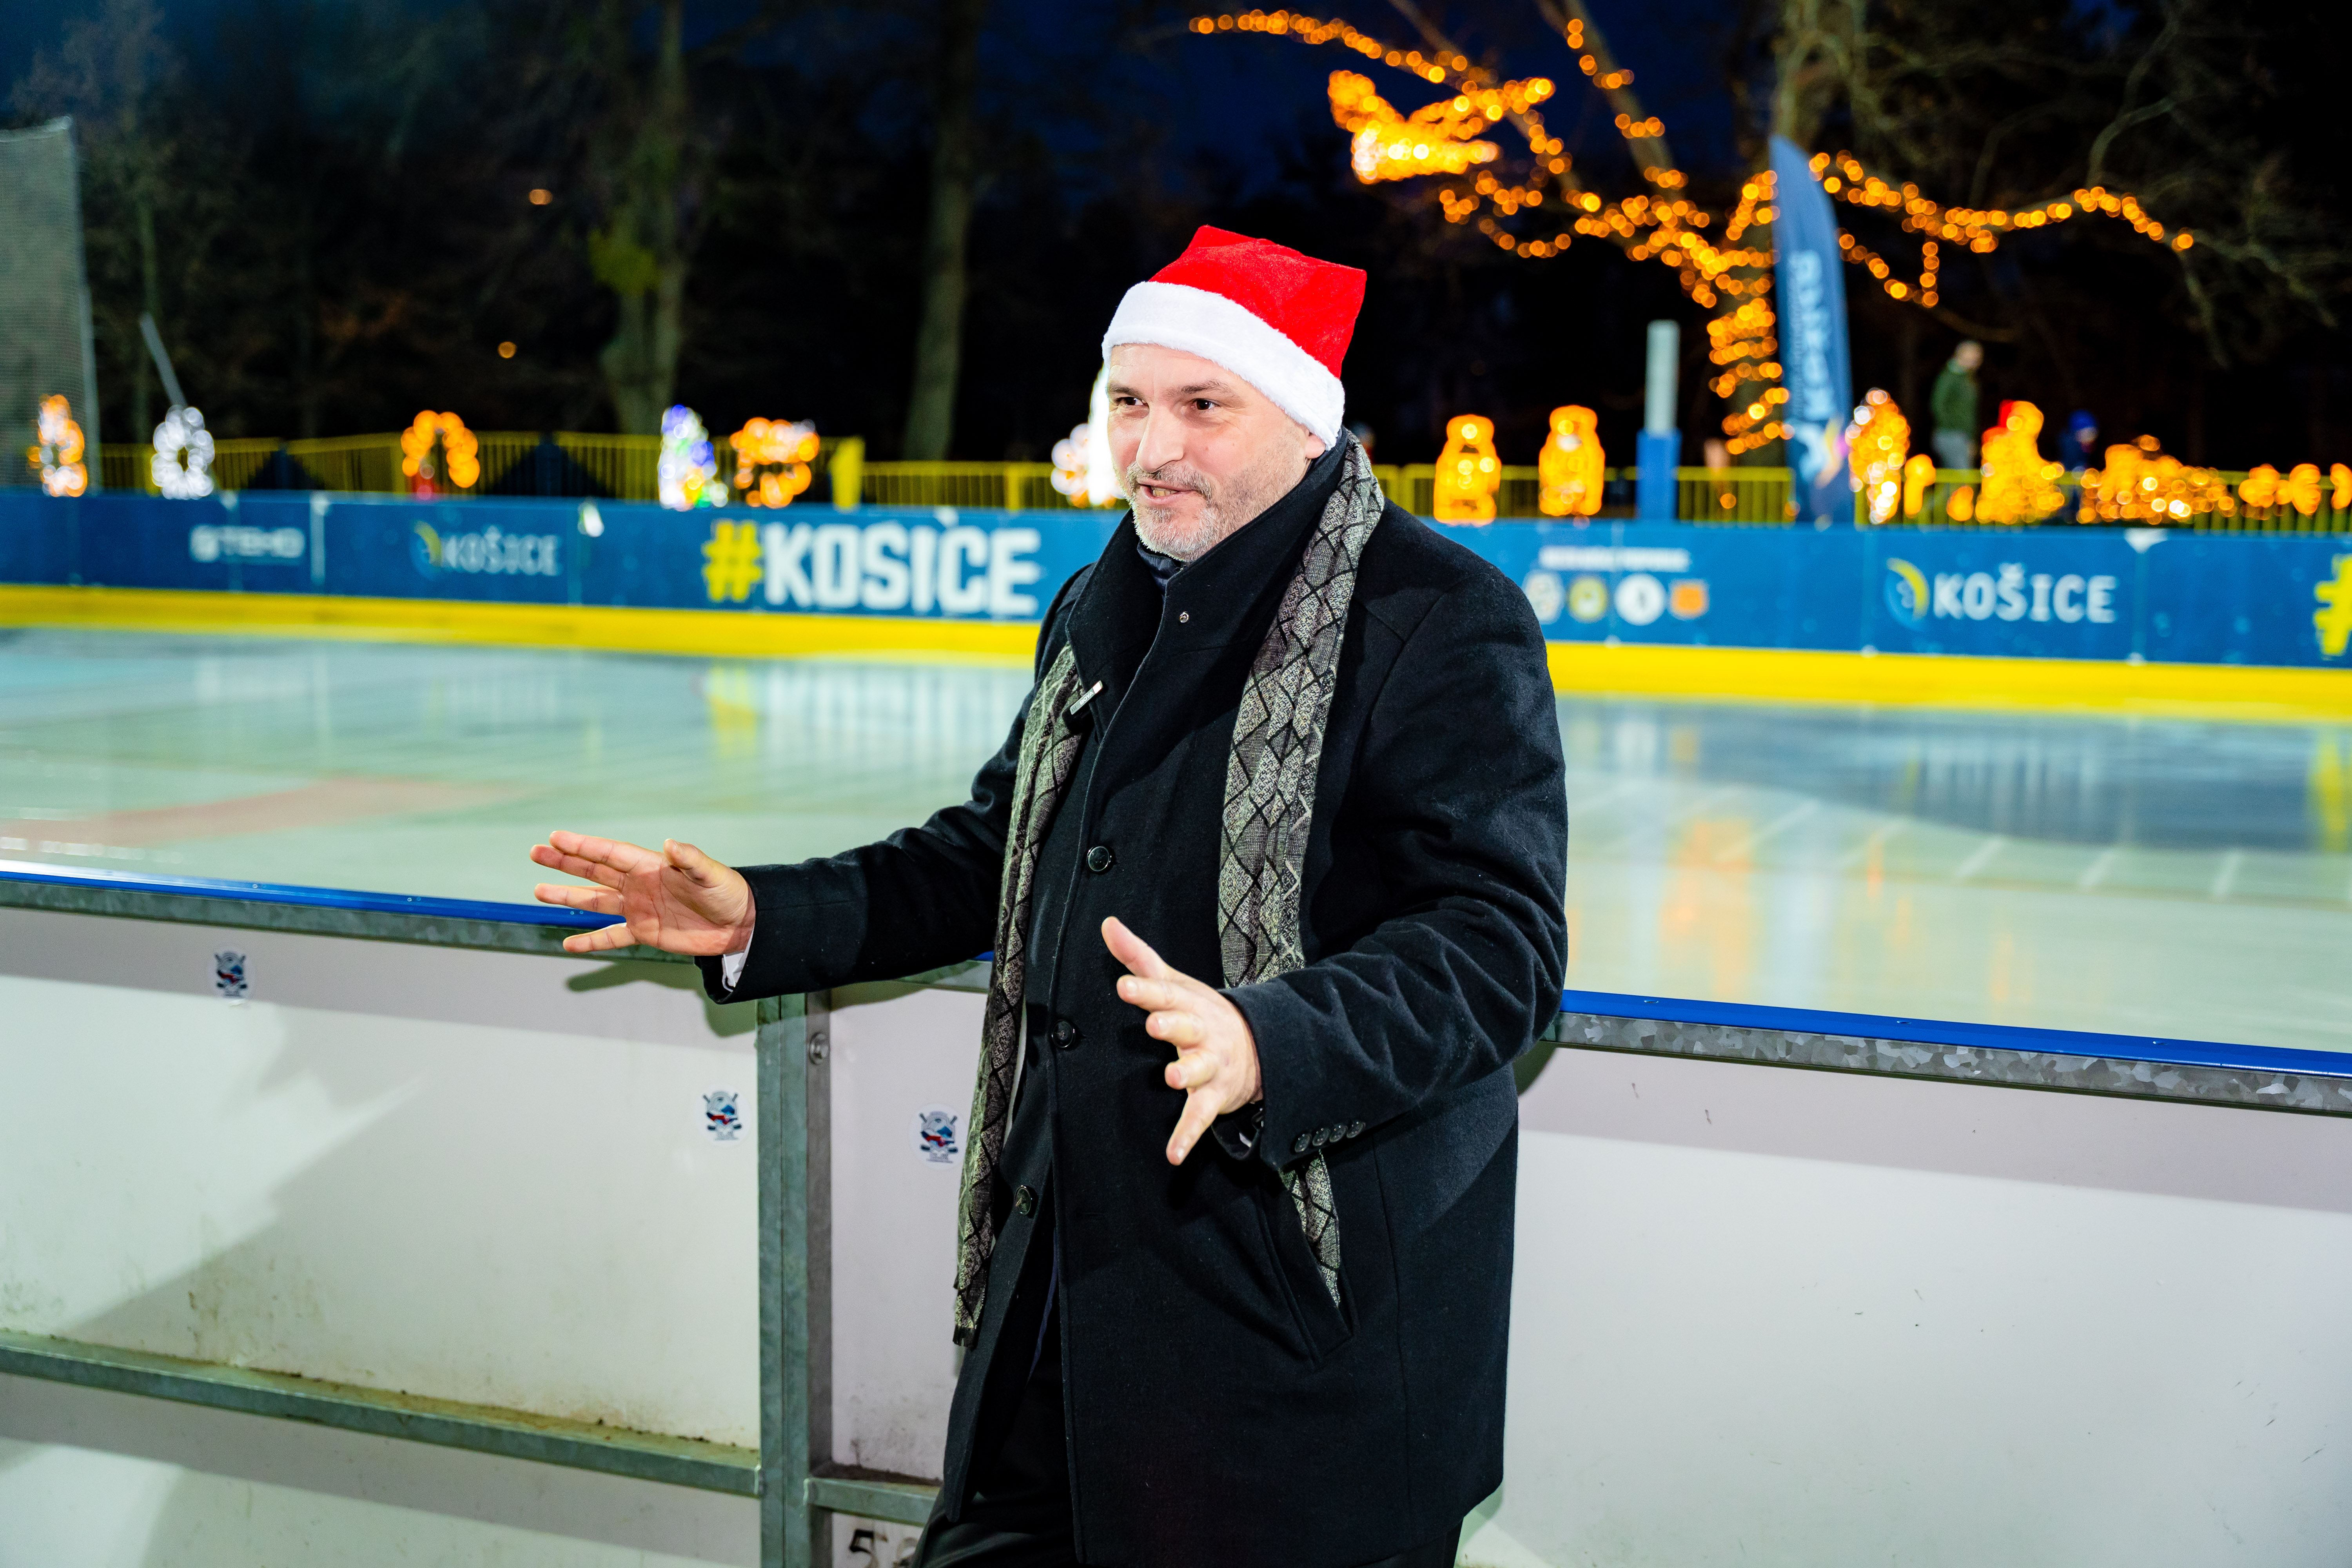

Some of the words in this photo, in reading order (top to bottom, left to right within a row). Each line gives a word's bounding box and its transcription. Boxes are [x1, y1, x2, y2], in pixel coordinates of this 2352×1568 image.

[439, 526, 561, 576] KOŠICE
[1933, 562, 2118, 623] KOŠICE
[1080, 691, 1094, 705] BOYA
